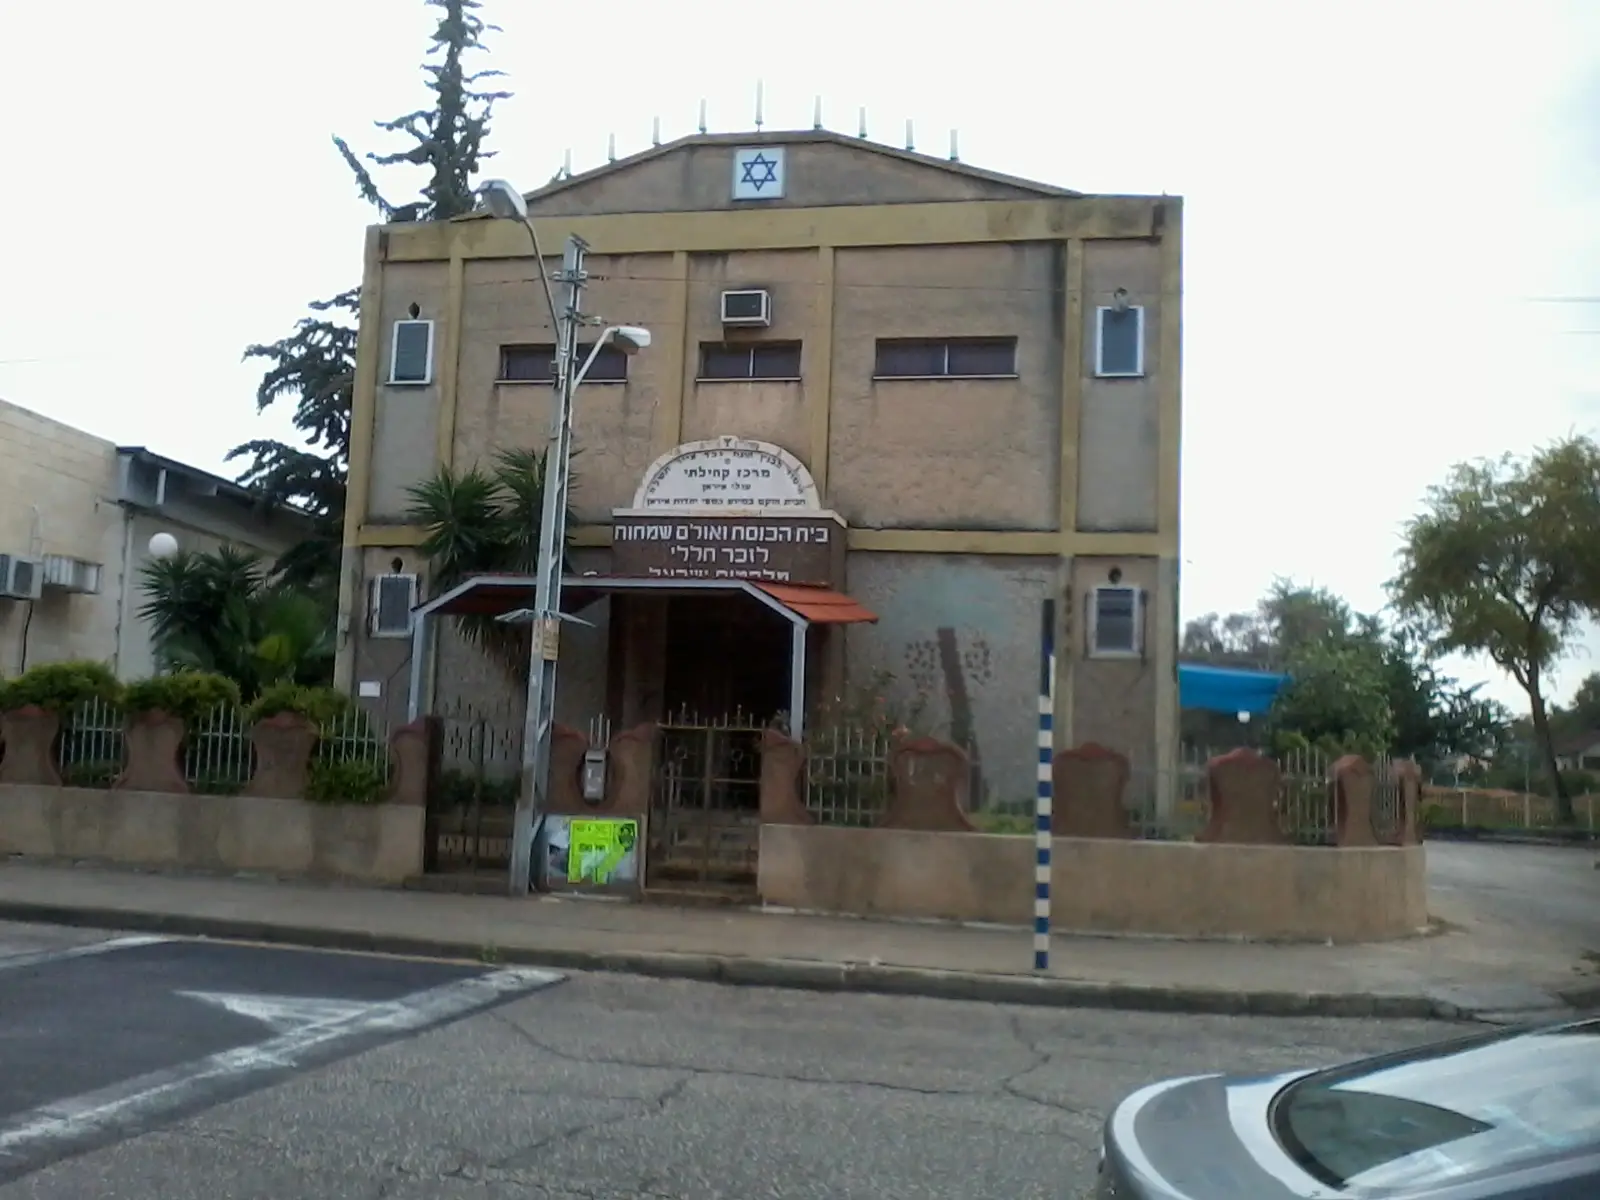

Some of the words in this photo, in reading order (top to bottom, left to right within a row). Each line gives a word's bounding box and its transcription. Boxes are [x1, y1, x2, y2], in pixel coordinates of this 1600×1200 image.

[737, 468, 771, 478] מרכז
[614, 524, 673, 541] שמחות
[676, 523, 728, 541] ואולם
[731, 525, 792, 543] הכנסת
[795, 526, 829, 543] בית
[671, 545, 716, 563] חללי
[721, 546, 769, 564] לזכר
